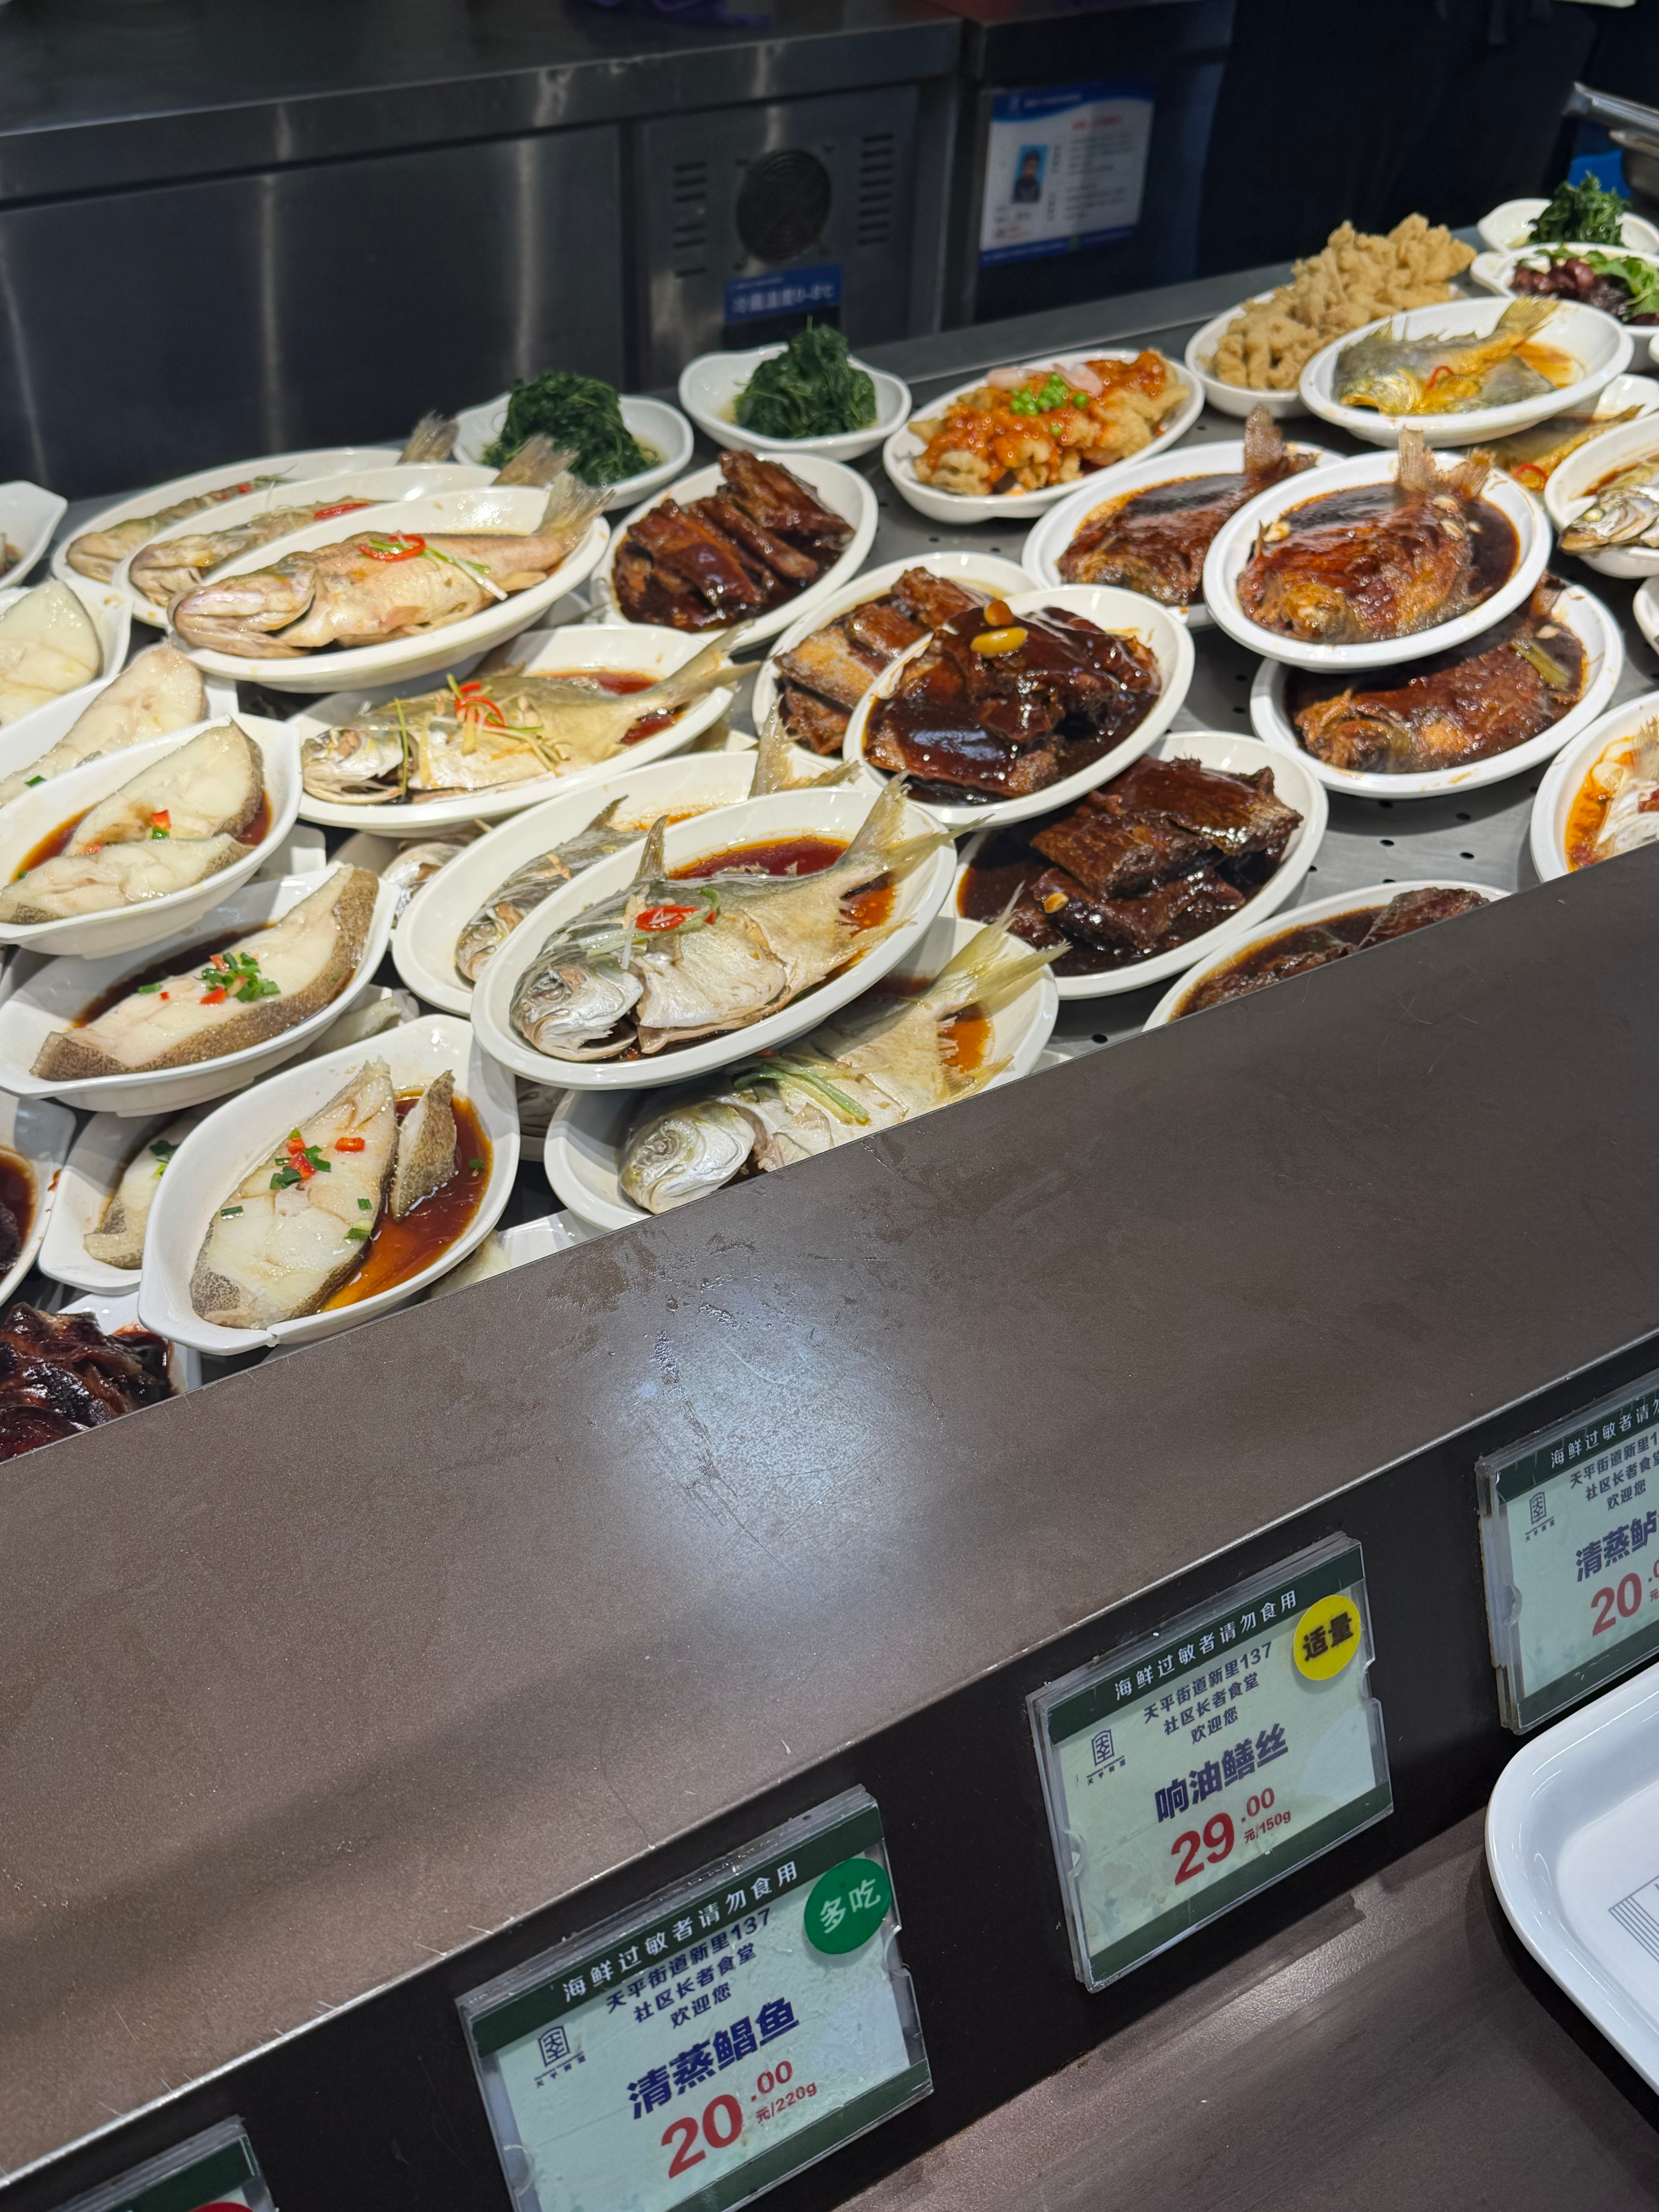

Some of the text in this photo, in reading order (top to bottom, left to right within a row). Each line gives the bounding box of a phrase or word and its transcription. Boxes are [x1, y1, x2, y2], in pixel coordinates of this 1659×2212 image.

[1607, 1479, 1646, 1511] 欢迎您
[1576, 1510, 1659, 1582] 清蒸鲈
[1115, 1590, 1296, 1701] 海鲜过敏者请勿食用
[1303, 1611, 1353, 1662] 适量
[1144, 1642, 1271, 1724] 天平街道新里137
[1164, 1671, 1259, 1735] 社区长者食堂
[1191, 1706, 1238, 1745] 欢迎您
[1155, 1723, 1288, 1823] 响油鳝丝
[1244, 1811, 1291, 1844] 元/150g
[563, 1861, 797, 2002] 海鲜过敏者请勿食用
[820, 1879, 881, 1934] 多吃
[606, 1908, 770, 2014] 天平街道新里137
[634, 1942, 756, 2023] 社区长者食堂
[671, 1982, 731, 2029] 欢迎您
[756, 2082, 817, 2124] 元/220g
